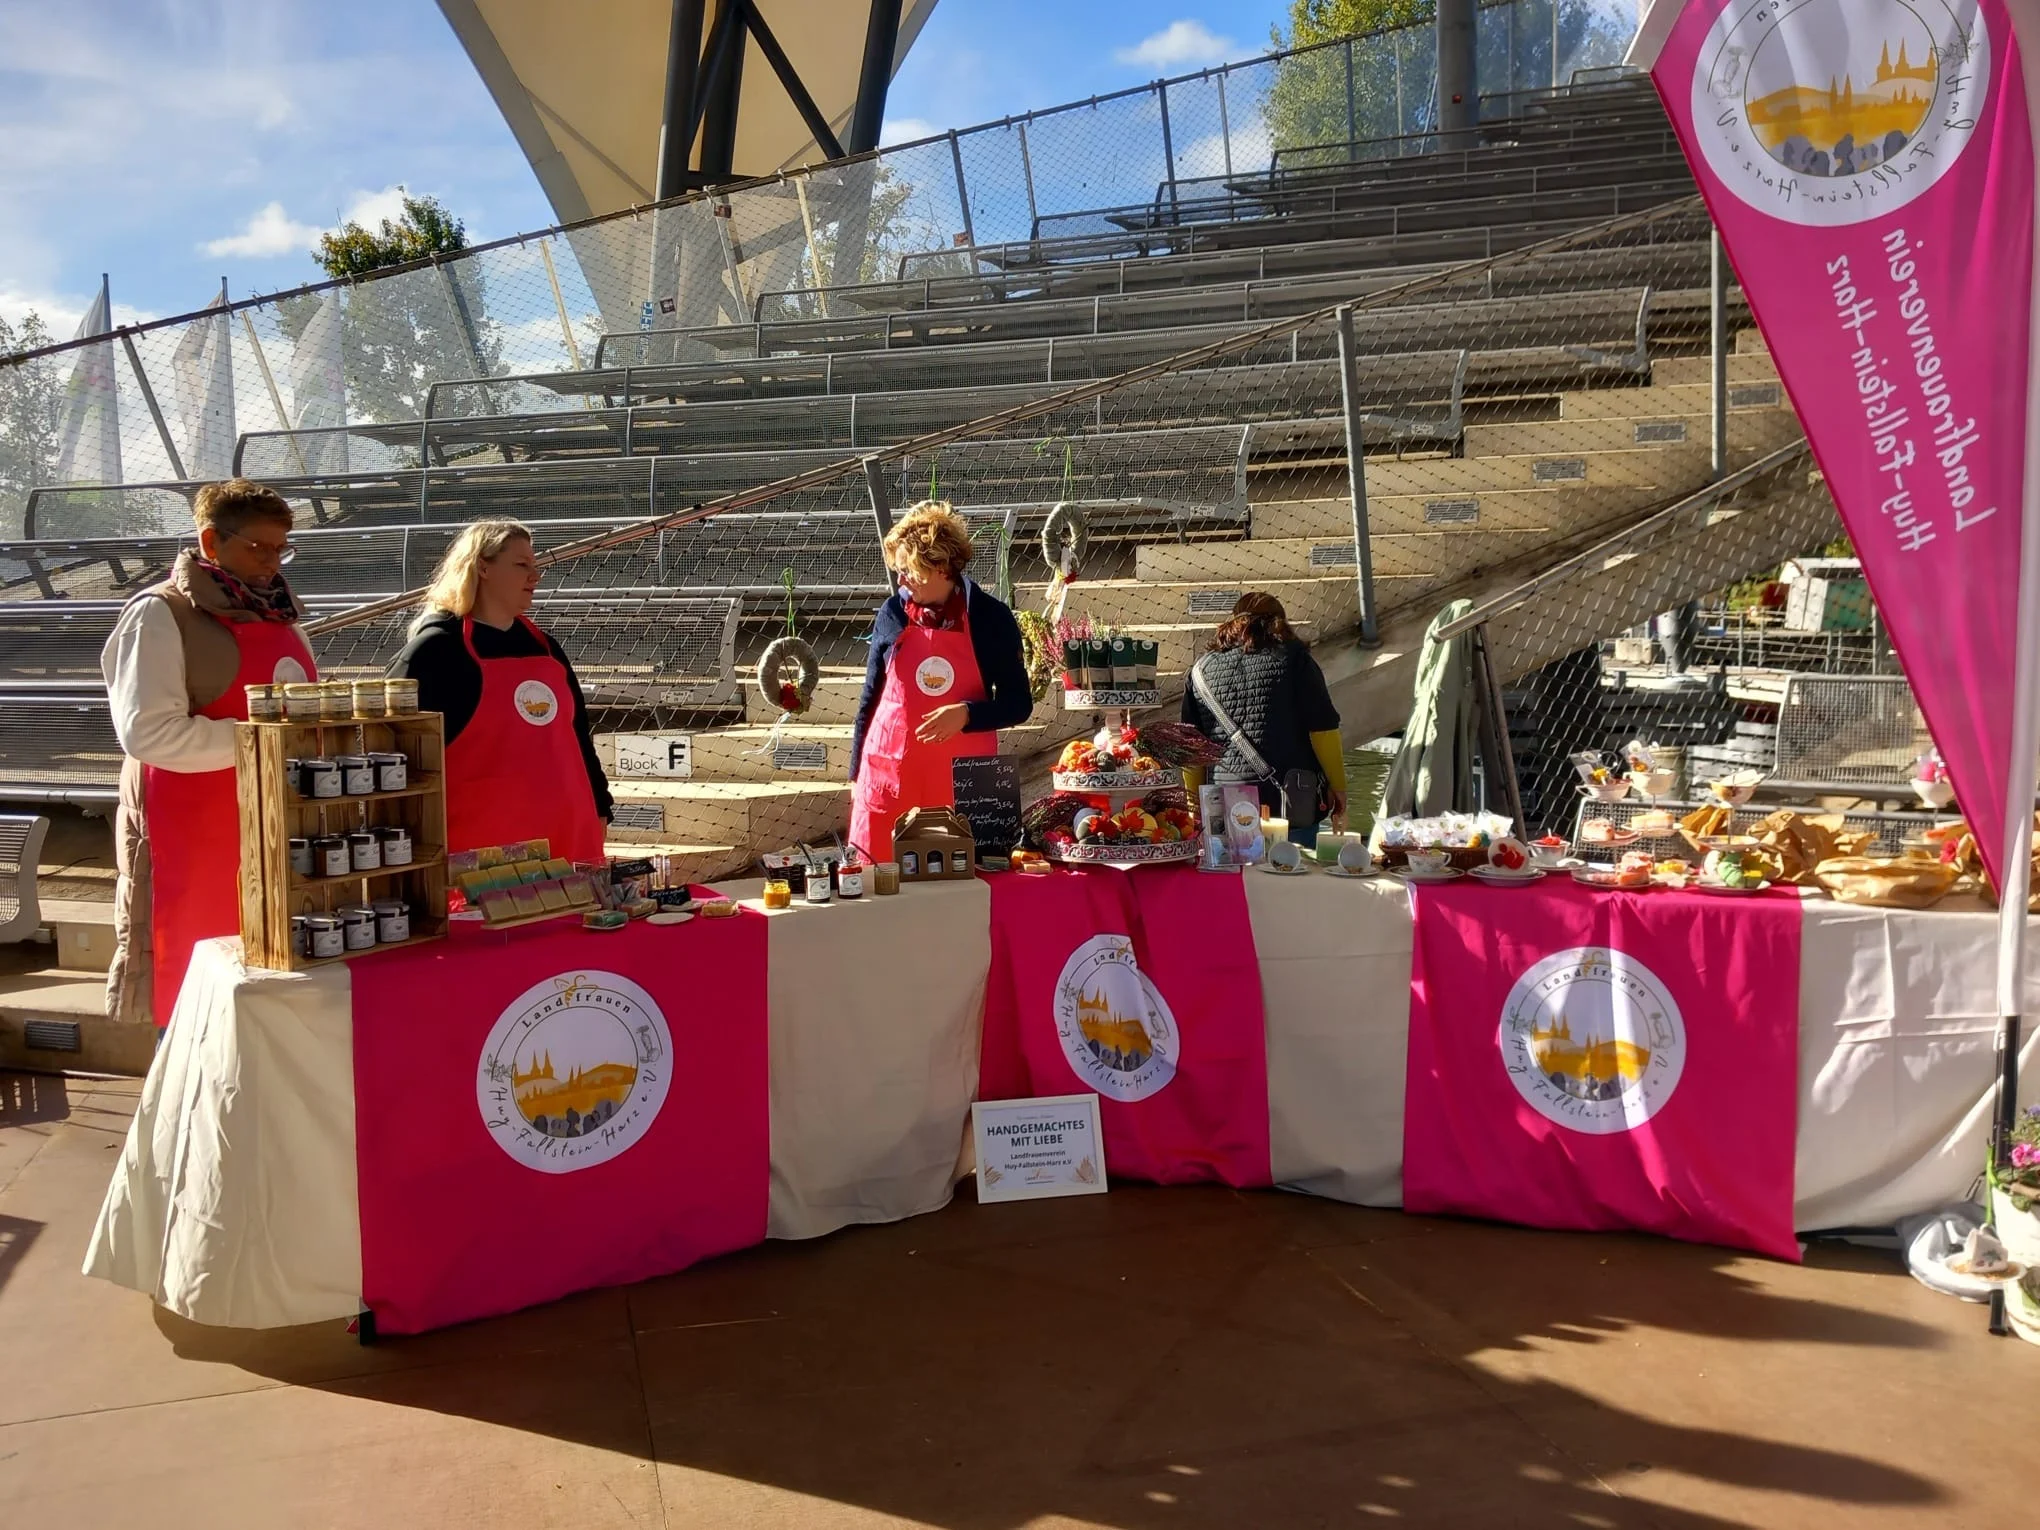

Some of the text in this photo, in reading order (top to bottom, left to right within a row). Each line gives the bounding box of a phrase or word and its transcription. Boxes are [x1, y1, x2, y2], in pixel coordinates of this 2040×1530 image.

[620, 743, 686, 770] Block F
[986, 1119, 1085, 1137] HANDGEMACHTES
[1010, 1134, 1063, 1148] MIT LIEBE
[1010, 1150, 1066, 1161] Landfrauenverein
